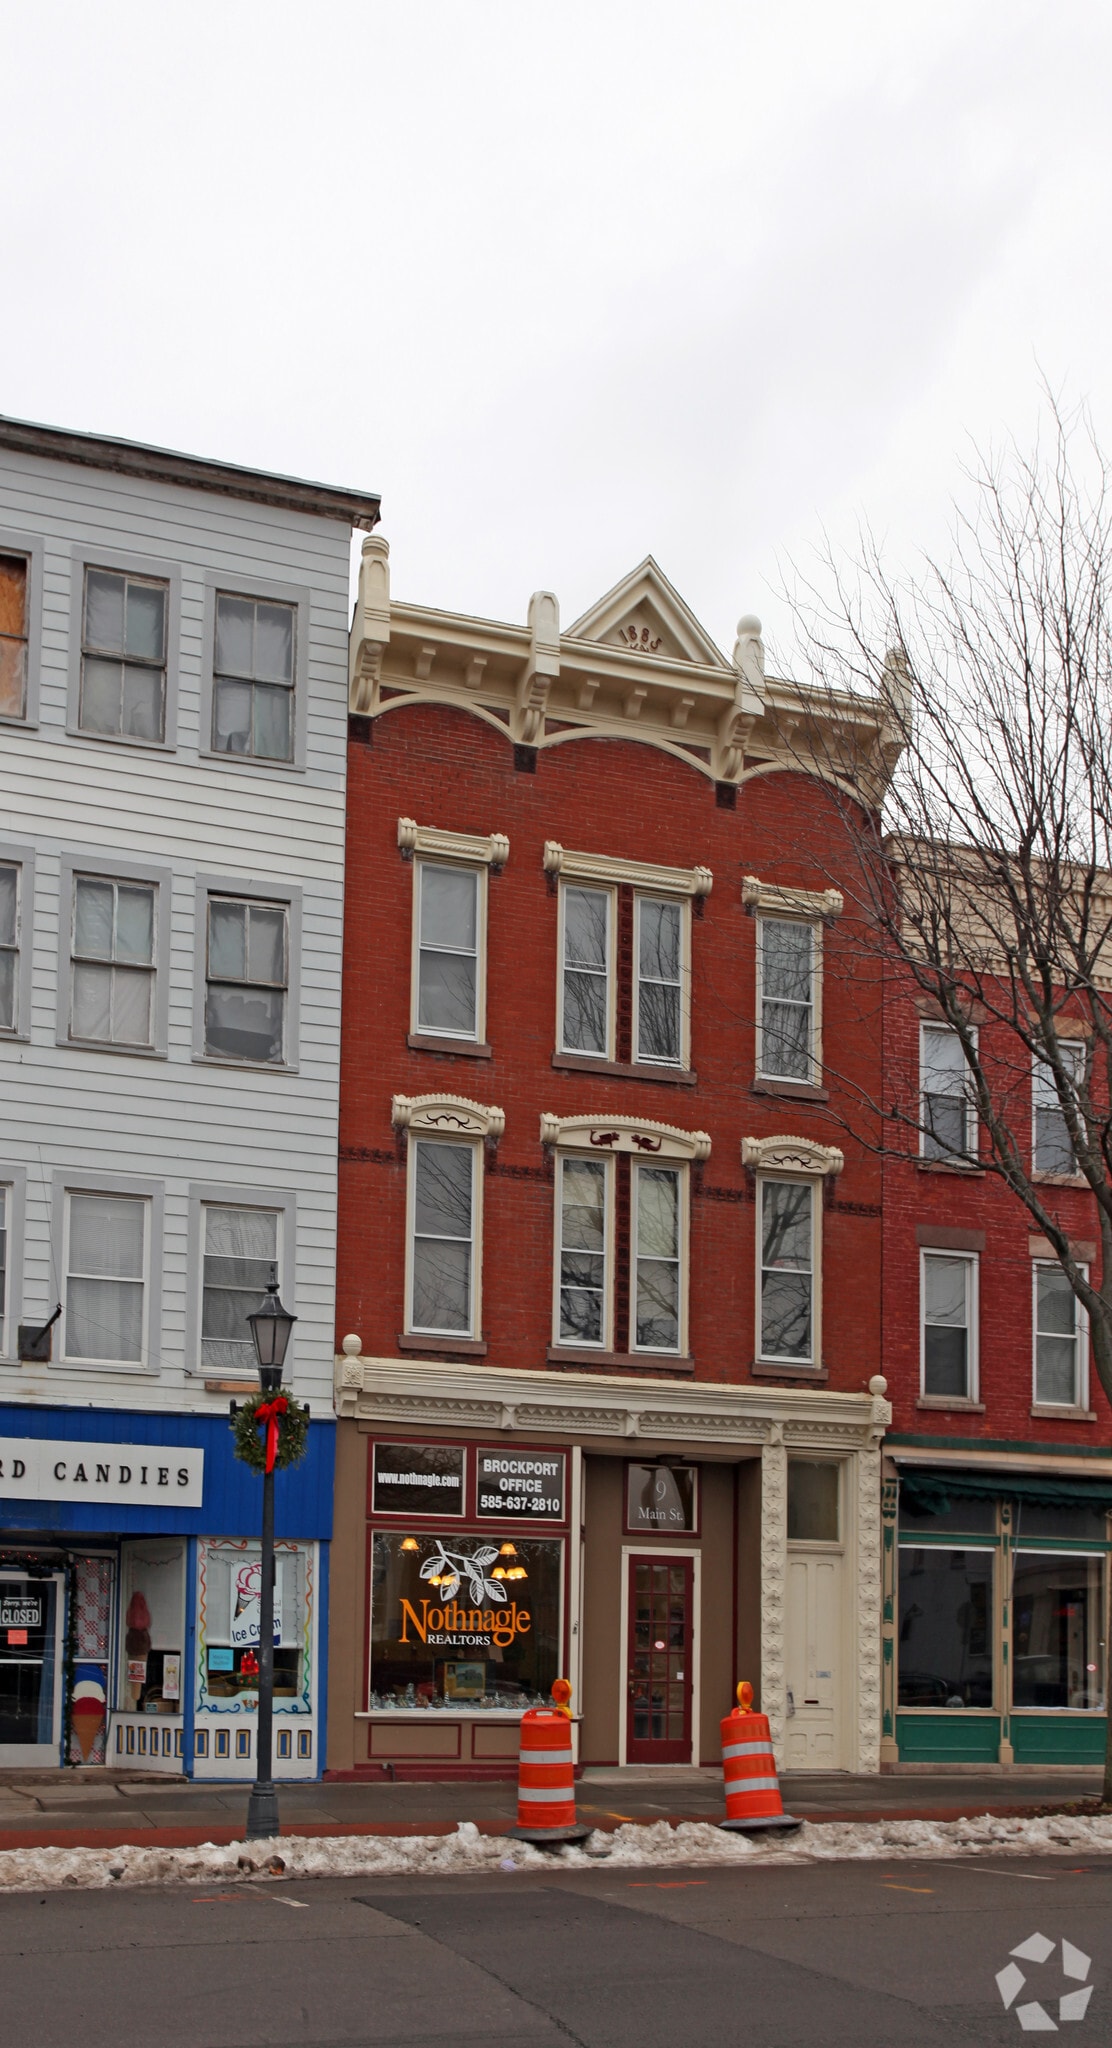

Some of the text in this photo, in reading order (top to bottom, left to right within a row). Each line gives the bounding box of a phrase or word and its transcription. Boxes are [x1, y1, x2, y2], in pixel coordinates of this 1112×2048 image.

[618, 625, 663, 650] 1885
[54, 1462, 189, 1486] CANDIES
[483, 1459, 559, 1476] BROCKPORT
[377, 1472, 460, 1488] www.nothnagle.com
[499, 1478, 543, 1493] OFFICE
[655, 1480, 667, 1502] 9
[480, 1495, 560, 1512] 585-637-2810
[638, 1507, 684, 1521] Main St.
[1, 1609, 39, 1624] CLOSED
[398, 1598, 531, 1647] Nothnagle
[231, 1629, 247, 1642] Ice
[427, 1634, 491, 1646] REALTORS
